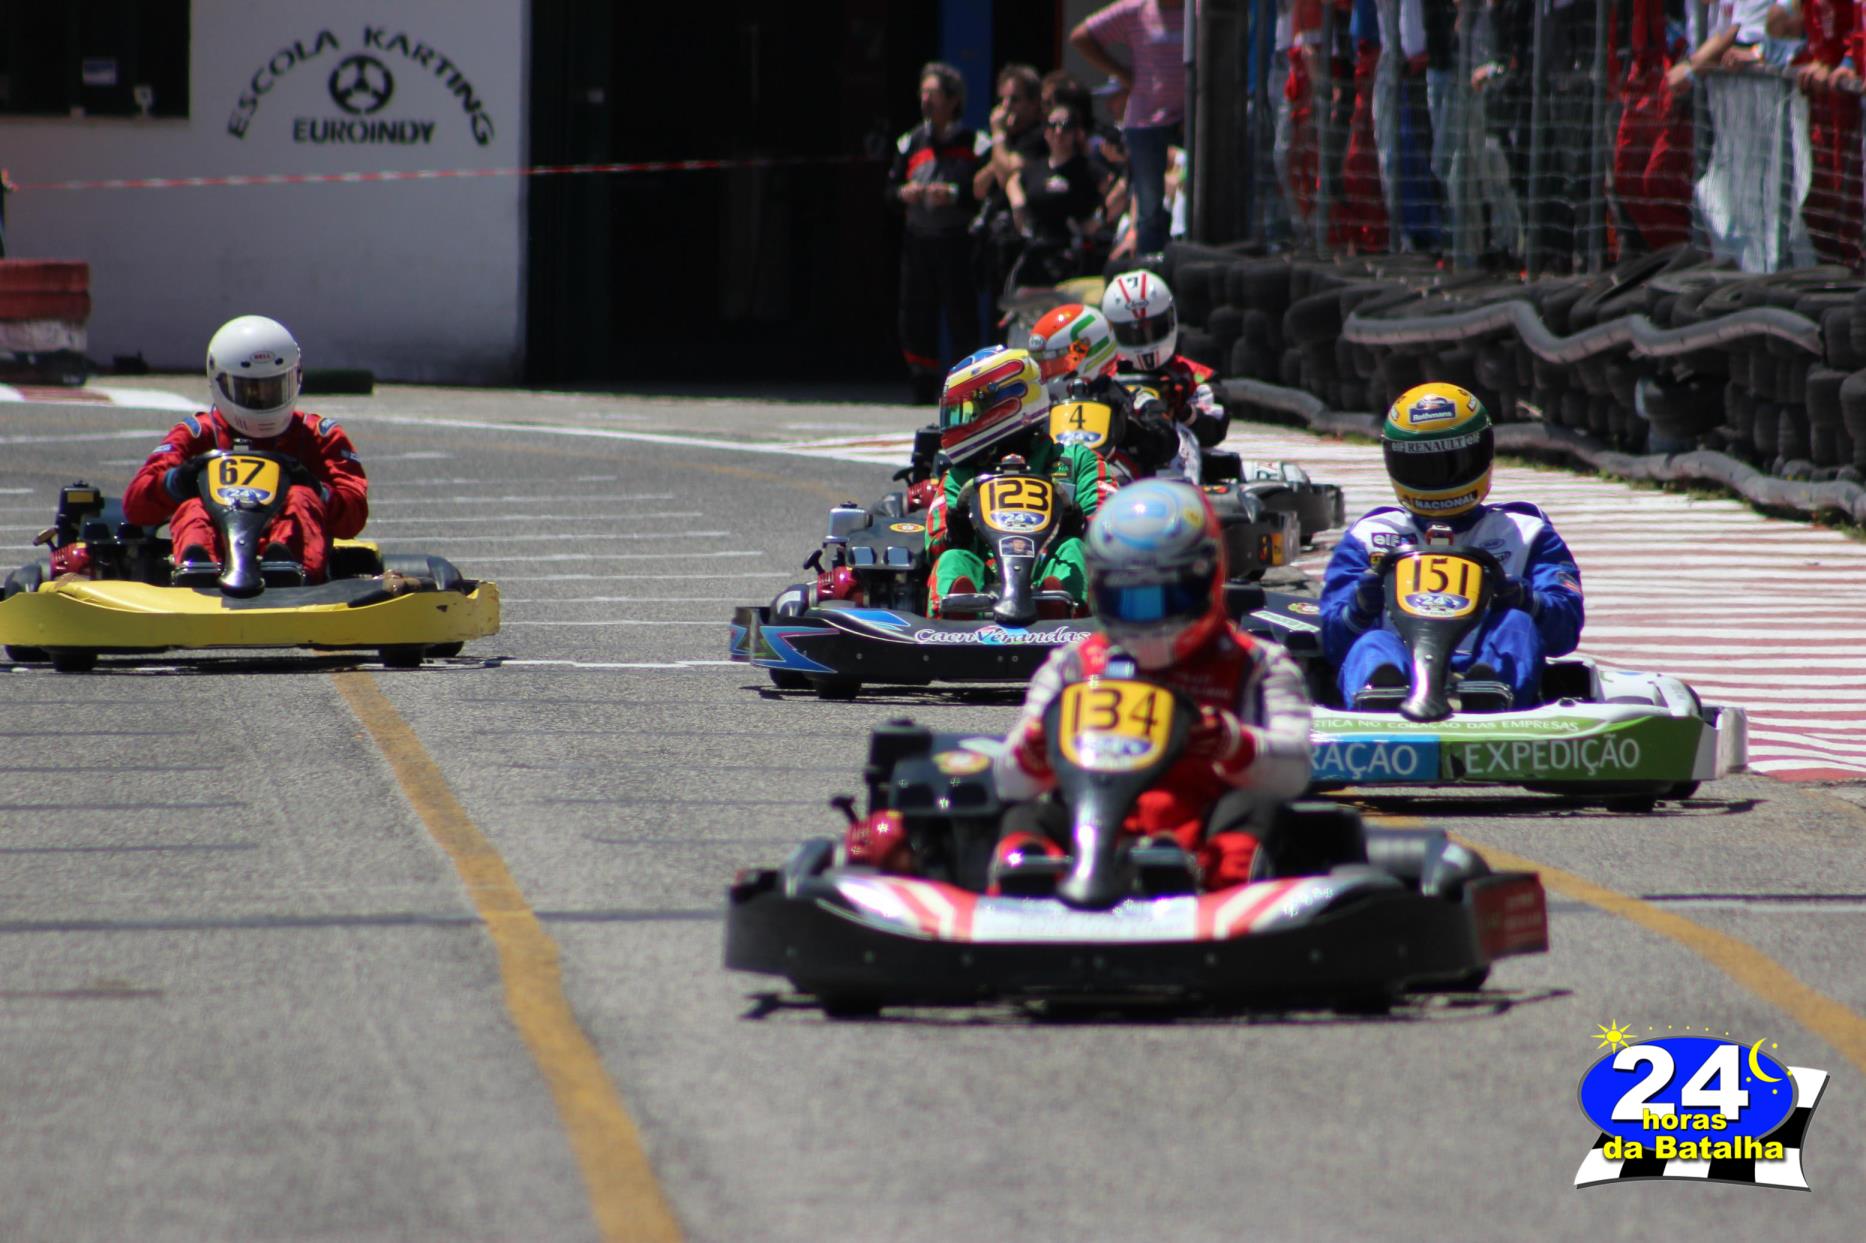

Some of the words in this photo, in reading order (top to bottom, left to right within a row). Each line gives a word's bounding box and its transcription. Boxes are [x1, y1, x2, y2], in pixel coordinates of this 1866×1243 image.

[228, 29, 340, 140] ESCOLA
[363, 25, 495, 146] KARTING
[293, 117, 435, 144] EUROINDY
[1069, 404, 1086, 430] 4
[1407, 437, 1464, 453] RENAULT
[219, 458, 266, 485] 67
[988, 479, 1049, 510] 123
[1415, 494, 1475, 510] NACIONAL
[1413, 558, 1469, 596] 151
[1073, 688, 1158, 736] 134
[1501, 720, 1580, 732] EMPRESAS
[1464, 734, 1640, 776] EXPEDIÇÃO
